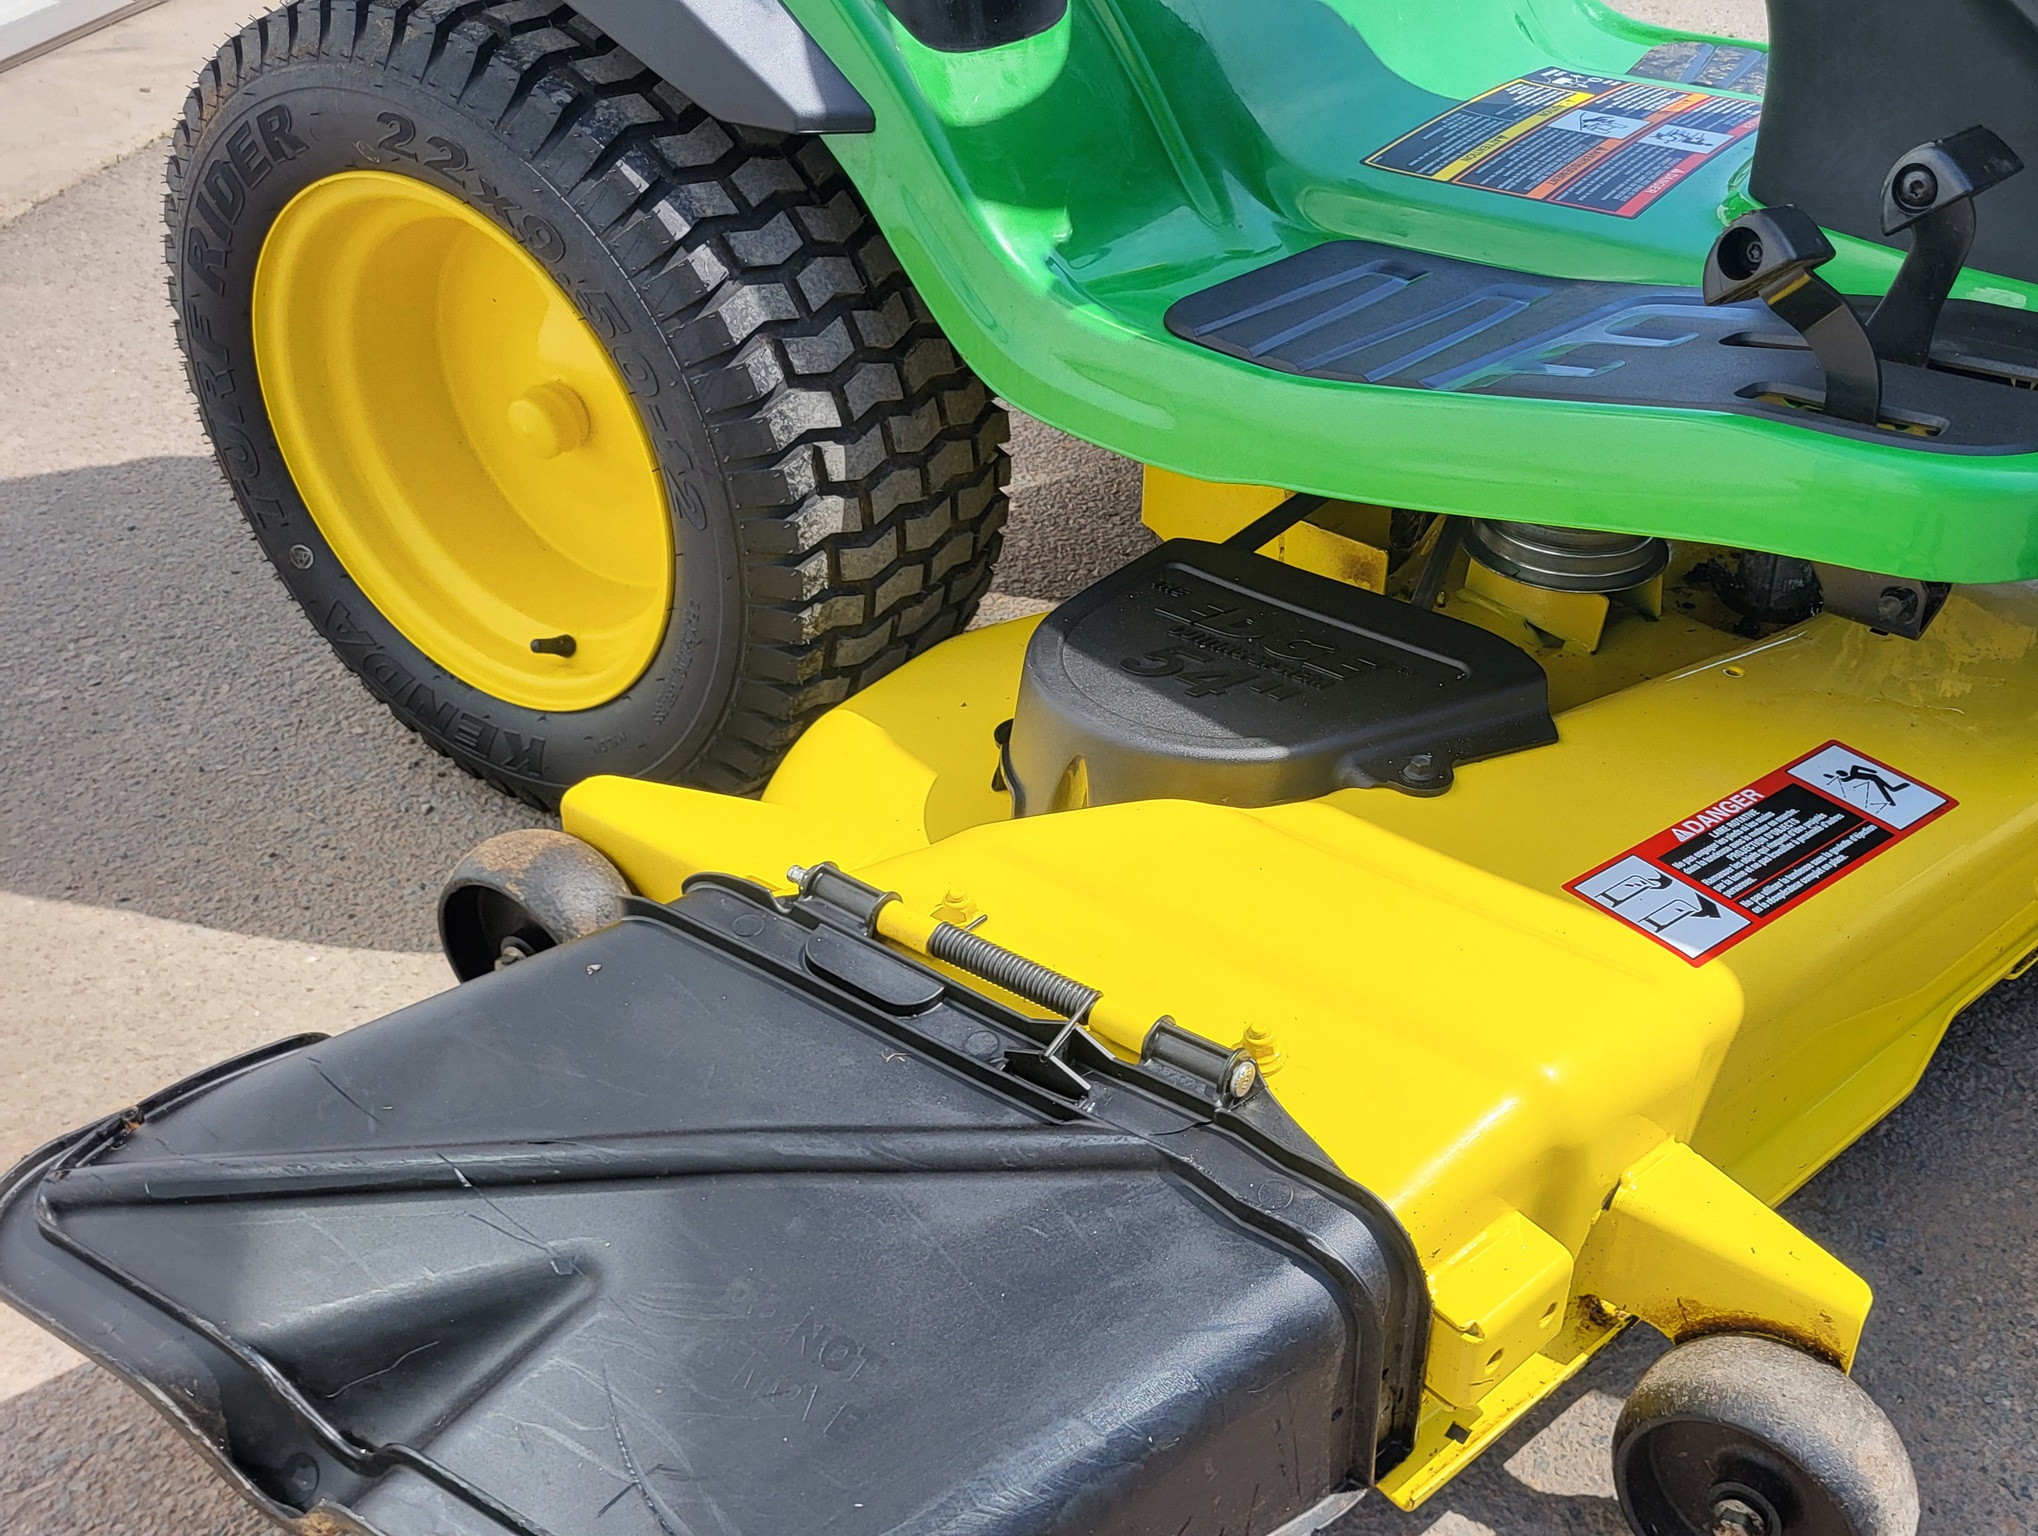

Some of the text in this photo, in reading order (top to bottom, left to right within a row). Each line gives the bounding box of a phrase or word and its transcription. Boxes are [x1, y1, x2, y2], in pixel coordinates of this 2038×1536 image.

[1459, 137, 1503, 162] ATTENTION
[1544, 149, 1602, 186] AVERTISSEMENT
[1643, 171, 1680, 194] DANGER
[187, 102, 309, 531] TURF RIDER
[324, 600, 547, 777] KENDA
[1685, 788, 1766, 836] DANGER
[1817, 811, 1846, 828] d'autres
[1706, 807, 1761, 838] LAME ROTATIVE
[1669, 809, 1777, 870] Ne pas engager les pieds ni les mains
[1679, 805, 1801, 875] dans la tondeuse avec le moteur en marche.
[1793, 823, 1827, 844] proximité
[1699, 811, 1830, 886] Ramasser les objets qui risquent d'être projetés
[1724, 835, 1770, 861] PROJECTION
[1764, 840, 1797, 859] travailler
[1819, 849, 1834, 858] la
[1825, 837, 1856, 855] goulotte
[1741, 865, 1755, 873] et
[1748, 861, 1762, 870] ne
[1755, 855, 1775, 866] pas
[1808, 854, 1828, 866] sans
[1726, 868, 1749, 882] lame
[1776, 875, 1791, 884] la
[1782, 861, 1815, 880] tondeuse
[1711, 881, 1730, 893] par
[1720, 877, 1734, 886] la
[1720, 875, 1760, 898] personnes.
[1749, 851, 1852, 914] ou le récupérateur complet en place.
[1757, 879, 1785, 896] utiliser
[1737, 897, 1755, 908] Ne
[1748, 891, 1768, 903] pas
